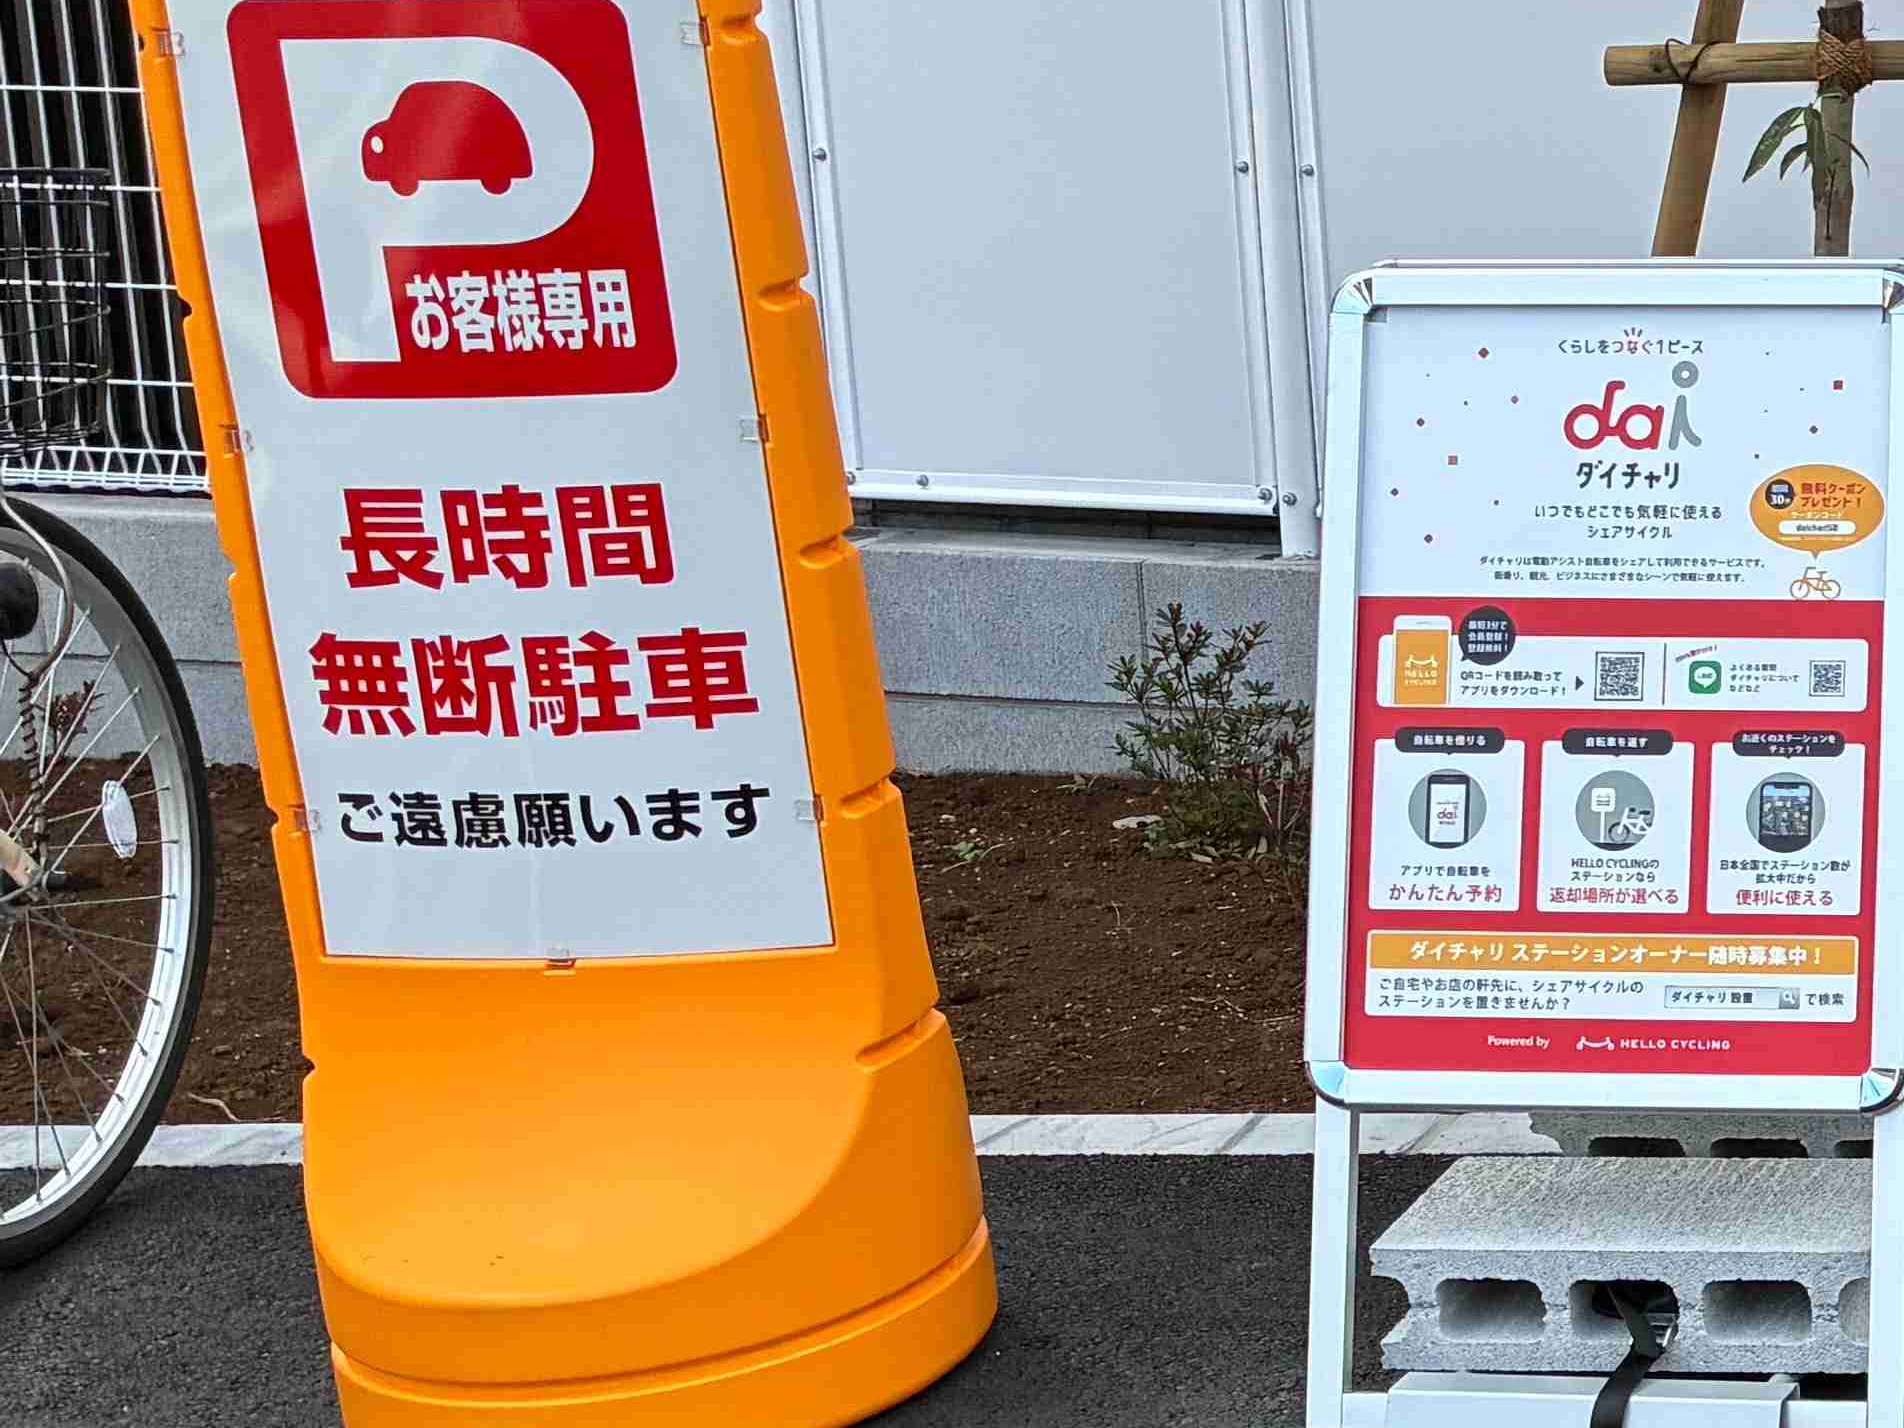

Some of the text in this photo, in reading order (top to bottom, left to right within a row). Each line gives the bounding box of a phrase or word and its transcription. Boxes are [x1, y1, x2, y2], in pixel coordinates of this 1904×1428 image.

[279, 36, 594, 363] P
[405, 267, 637, 353] お客様専用
[1558, 339, 1704, 355] くらしをつなぐ1ピース
[1564, 360, 1702, 450] dai
[1576, 459, 1681, 490] ダイチャリ
[1534, 504, 1722, 520] いつでもどこでも気軽に使える
[339, 483, 677, 591] 長時間
[1587, 525, 1673, 540] シェアサイクル
[309, 627, 760, 739] 無断駐車
[336, 783, 771, 850] ご遠慮願います
[1400, 864, 1491, 877] アプリで自転車を
[1719, 859, 1851, 872] 日本全国でステーション数が
[1570, 870, 1656, 883] ステーションなら
[1388, 883, 1503, 904] かんたん予約
[1549, 886, 1680, 905] 返却場所が選べる
[1735, 889, 1834, 907] 便利に使える
[1410, 940, 1822, 966] ダイチャリ ステーションオーナー随時募集中！
[1379, 977, 1645, 994] ご自宅やお店の軒先に、シェアサイクルの
[1378, 994, 1571, 1011] ステーションを置きませんか？
[1671, 991, 1730, 1004] ダイチャリ
[1805, 992, 1845, 1007] で検索
[1487, 1034, 1551, 1050] Powered by
[1619, 1038, 1731, 1051] HELLO CYCLING
